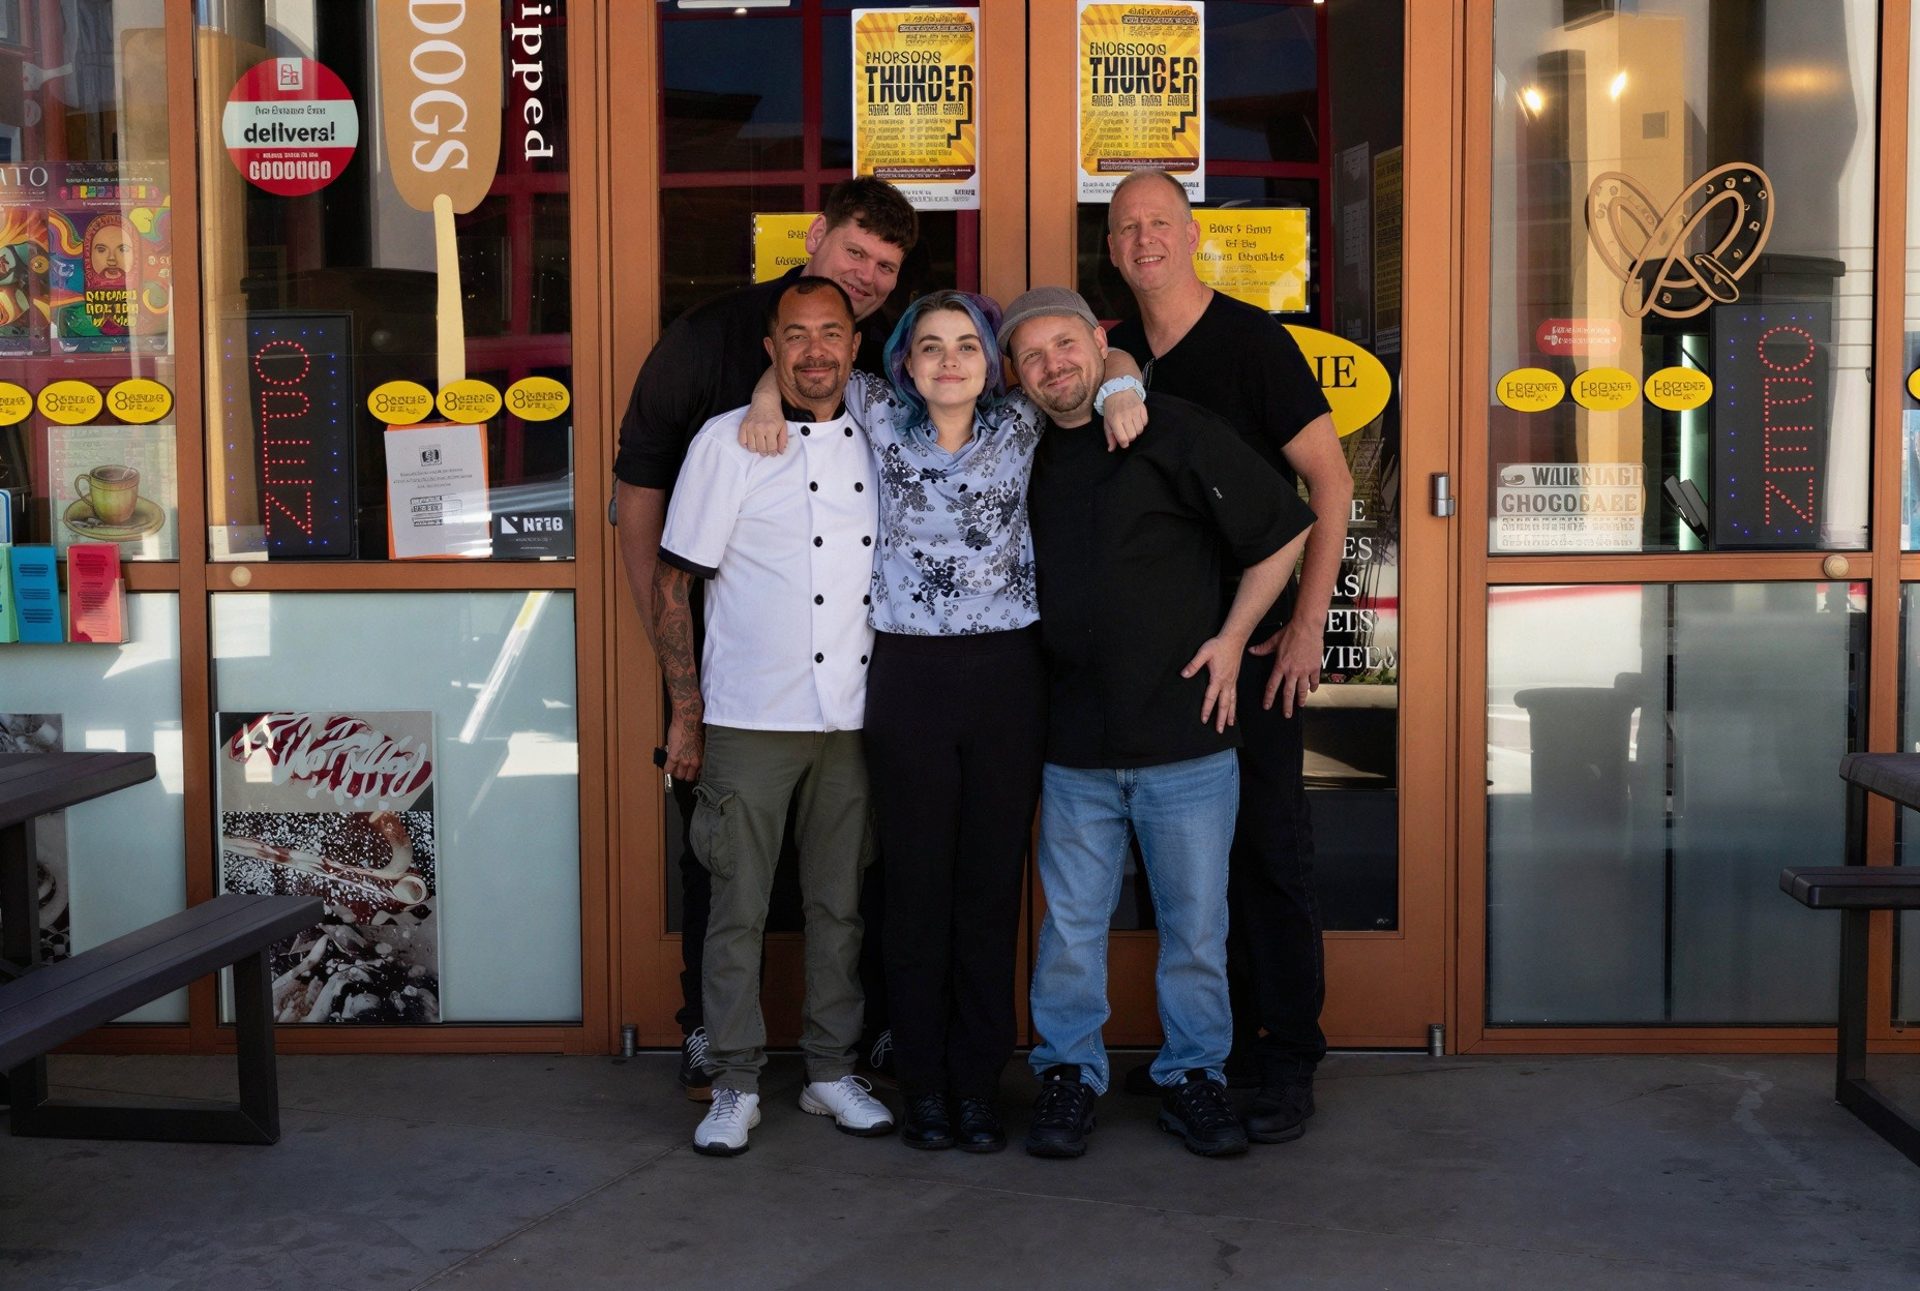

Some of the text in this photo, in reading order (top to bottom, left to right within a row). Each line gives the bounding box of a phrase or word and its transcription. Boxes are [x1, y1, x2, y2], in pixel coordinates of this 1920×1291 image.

[409, 0, 469, 173] DOGS
[511, 3, 553, 162] ipped
[255, 340, 312, 537] OPEN
[1757, 325, 1817, 526] OPEN
[1342, 536, 1373, 561] ES
